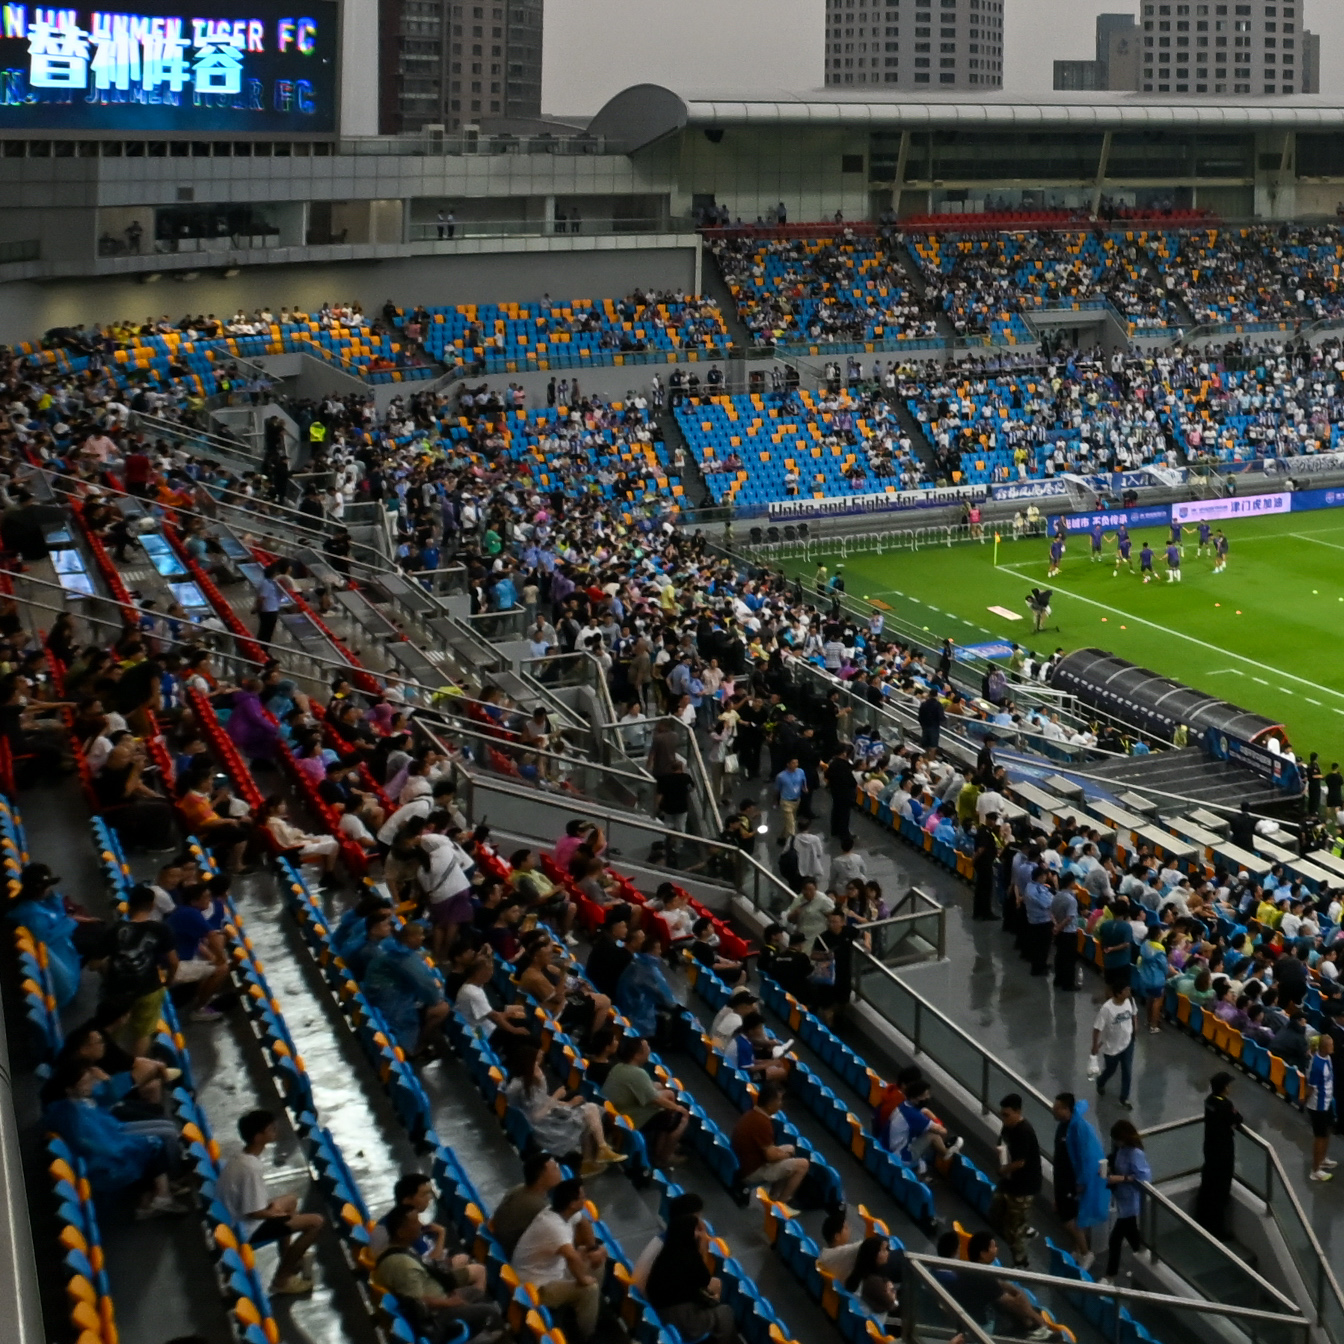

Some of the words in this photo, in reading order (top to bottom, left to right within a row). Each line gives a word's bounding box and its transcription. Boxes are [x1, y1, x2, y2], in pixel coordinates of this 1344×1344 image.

[278, 17, 317, 56] FC
[27, 22, 244, 94] 替补阵容
[771, 502, 814, 518] Unite
[819, 498, 848, 514] and
[851, 494, 892, 511] Fight
[896, 493, 918, 507] for
[1231, 497, 1283, 513] 津门虎加油
